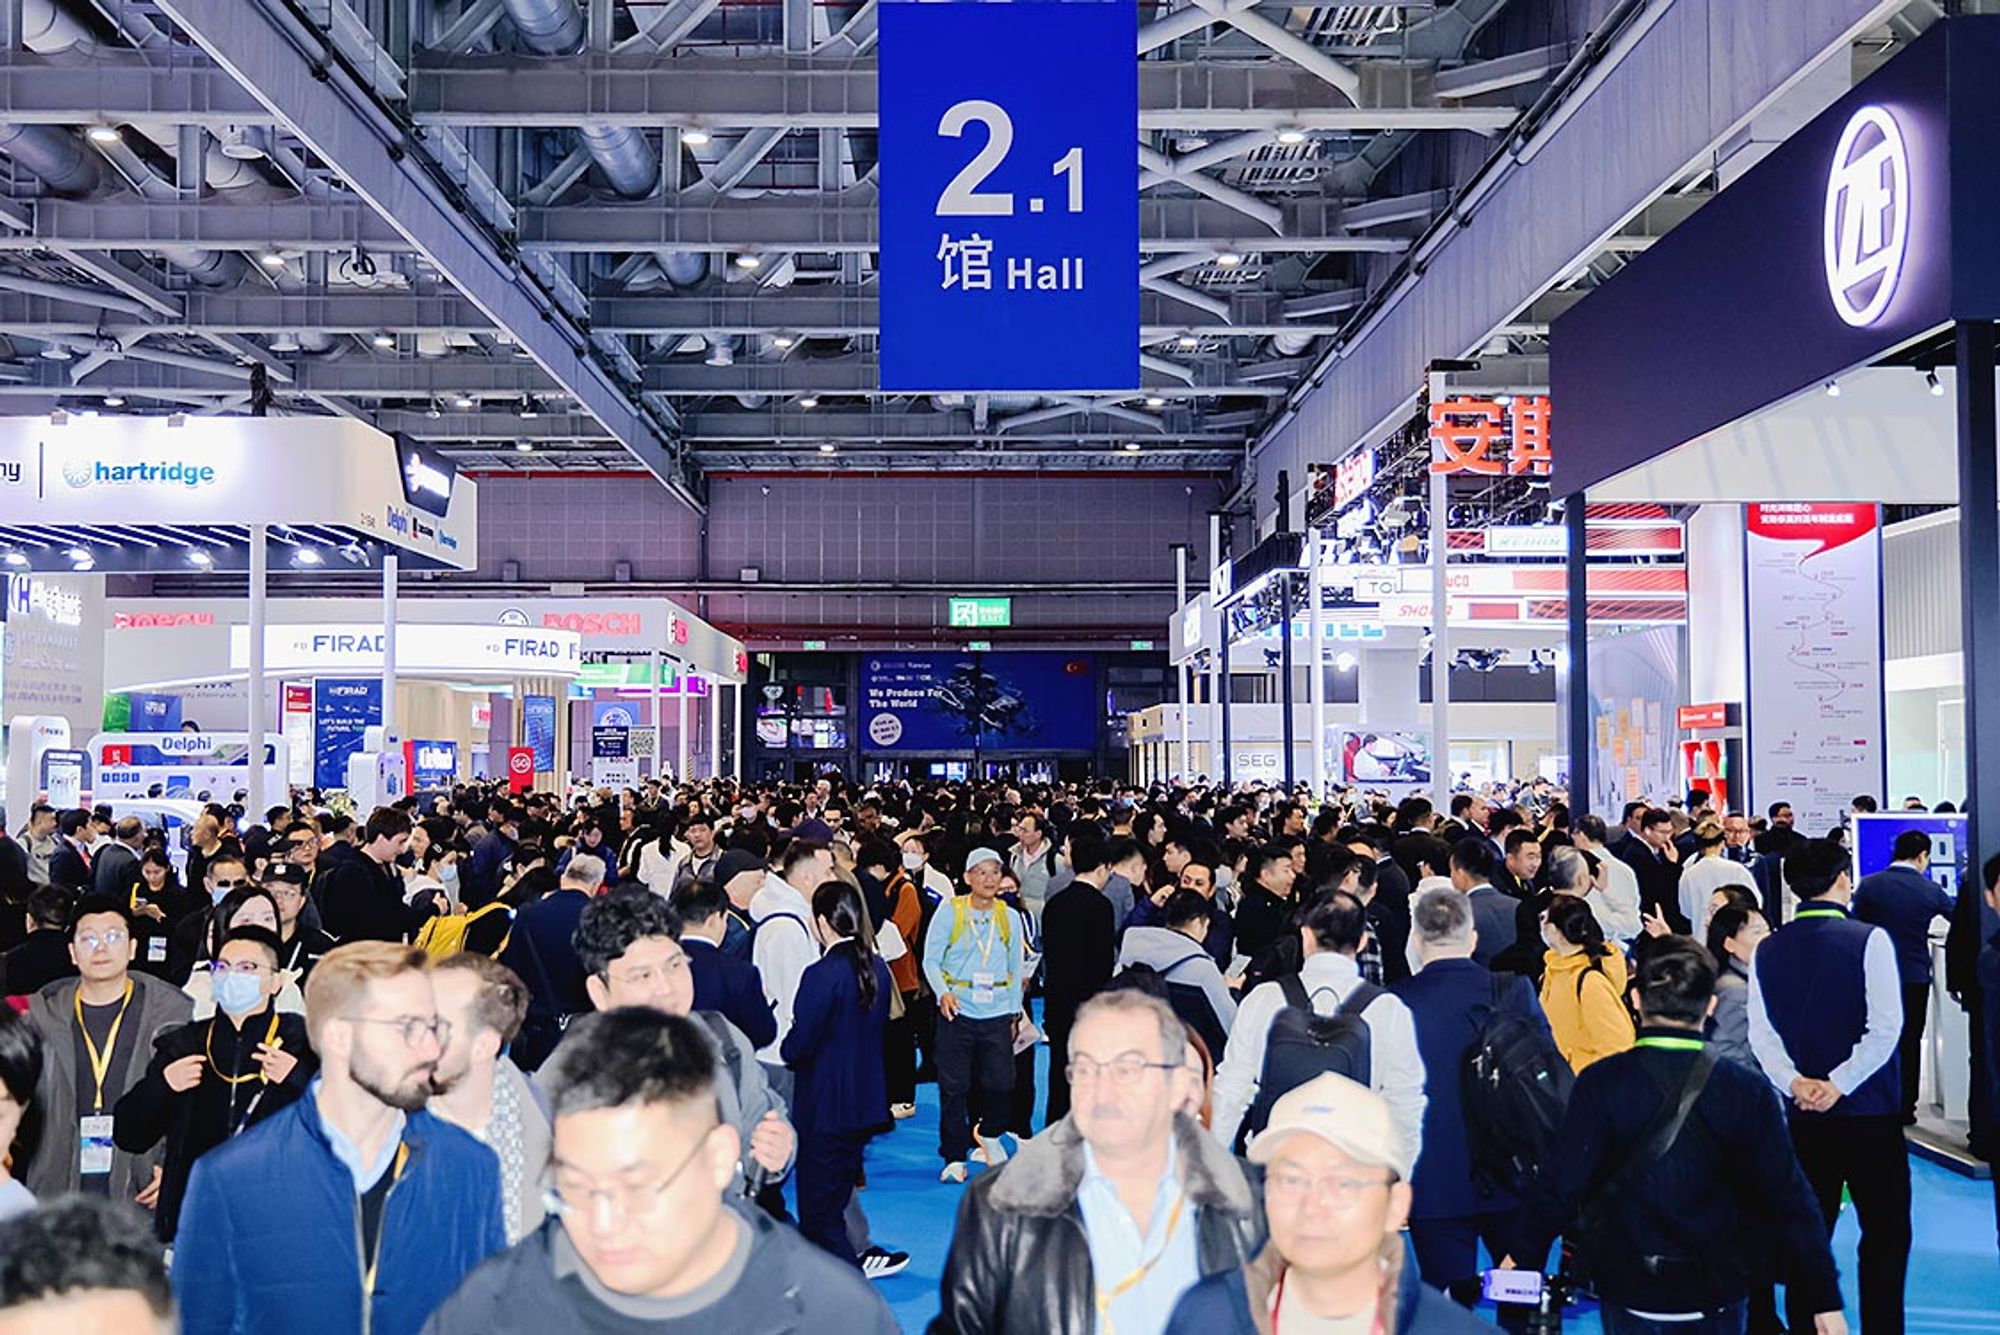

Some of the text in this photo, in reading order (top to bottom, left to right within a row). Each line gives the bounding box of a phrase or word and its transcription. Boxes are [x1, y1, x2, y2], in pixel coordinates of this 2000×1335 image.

[936, 100, 1083, 217] 2.1
[936, 233, 1084, 291] 馆 Hall
[95, 461, 215, 485] hartridge
[1399, 604, 1453, 617] SHOA
[543, 613, 641, 636] BOSCH
[505, 638, 560, 658] FIRAD
[886, 688, 925, 698] Produce
[868, 699, 918, 708] The World
[161, 736, 212, 752] Delphi
[1238, 754, 1276, 767] SEG
